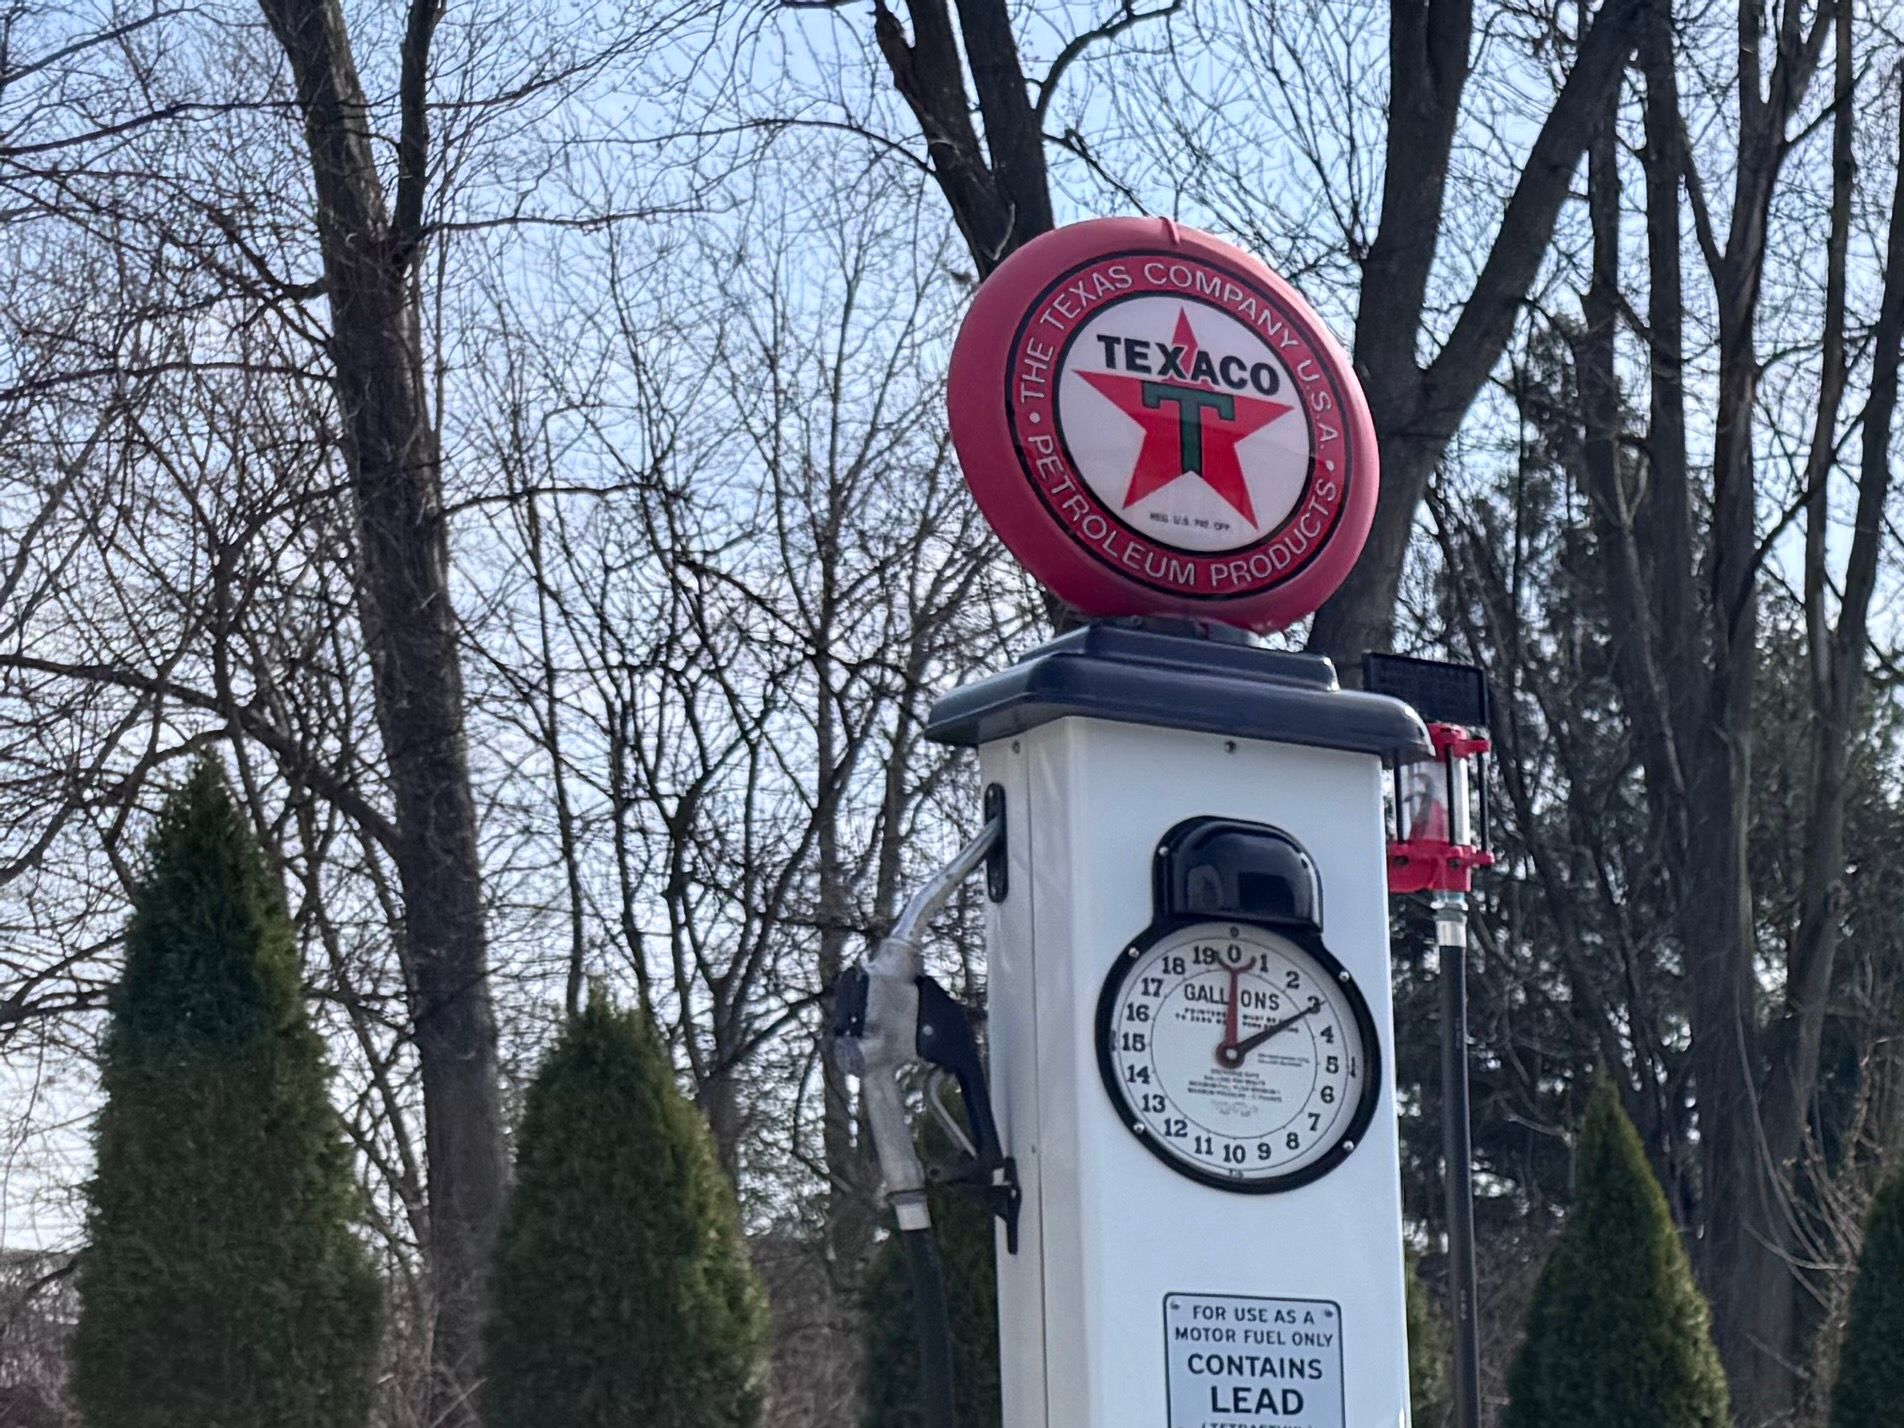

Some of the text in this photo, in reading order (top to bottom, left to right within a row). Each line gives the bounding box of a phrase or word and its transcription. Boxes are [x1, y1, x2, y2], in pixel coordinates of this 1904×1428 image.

[1021, 338, 1054, 403] THE
[1040, 265, 1133, 330] TEXAS
[1144, 262, 1299, 348] COMPANY
[1096, 334, 1280, 396] TEXACO
[1141, 380, 1236, 475] T
[1027, 435, 1336, 587] PETROLEUM PRODUCTS
[1192, 947, 1217, 965] 19
[1227, 944, 1241, 963] 0
[1162, 957, 1186, 975] 18
[1259, 955, 1269, 973] 1
[1141, 978, 1165, 997] 17
[1286, 972, 1300, 988] 2
[1126, 1003, 1150, 1021] 16
[1121, 1033, 1146, 1052] 15
[1321, 1026, 1334, 1043] 4
[1127, 1065, 1151, 1084] 14
[1326, 1057, 1339, 1074] 5
[1143, 1095, 1166, 1113] 13
[1321, 1086, 1335, 1103] 6
[1164, 1119, 1188, 1137] 12
[1308, 1113, 1321, 1132] 7
[1194, 1137, 1213, 1155] 11
[1257, 1142, 1271, 1160] 9
[1286, 1133, 1299, 1150] 8
[1224, 1144, 1245, 1164] 10
[1193, 1305, 1315, 1325] FOR USE AS A
[1175, 1327, 1333, 1348] MOTOR FUEL ONLY
[1188, 1353, 1323, 1380] CONTAINS
[1210, 1385, 1304, 1416] LEAD
